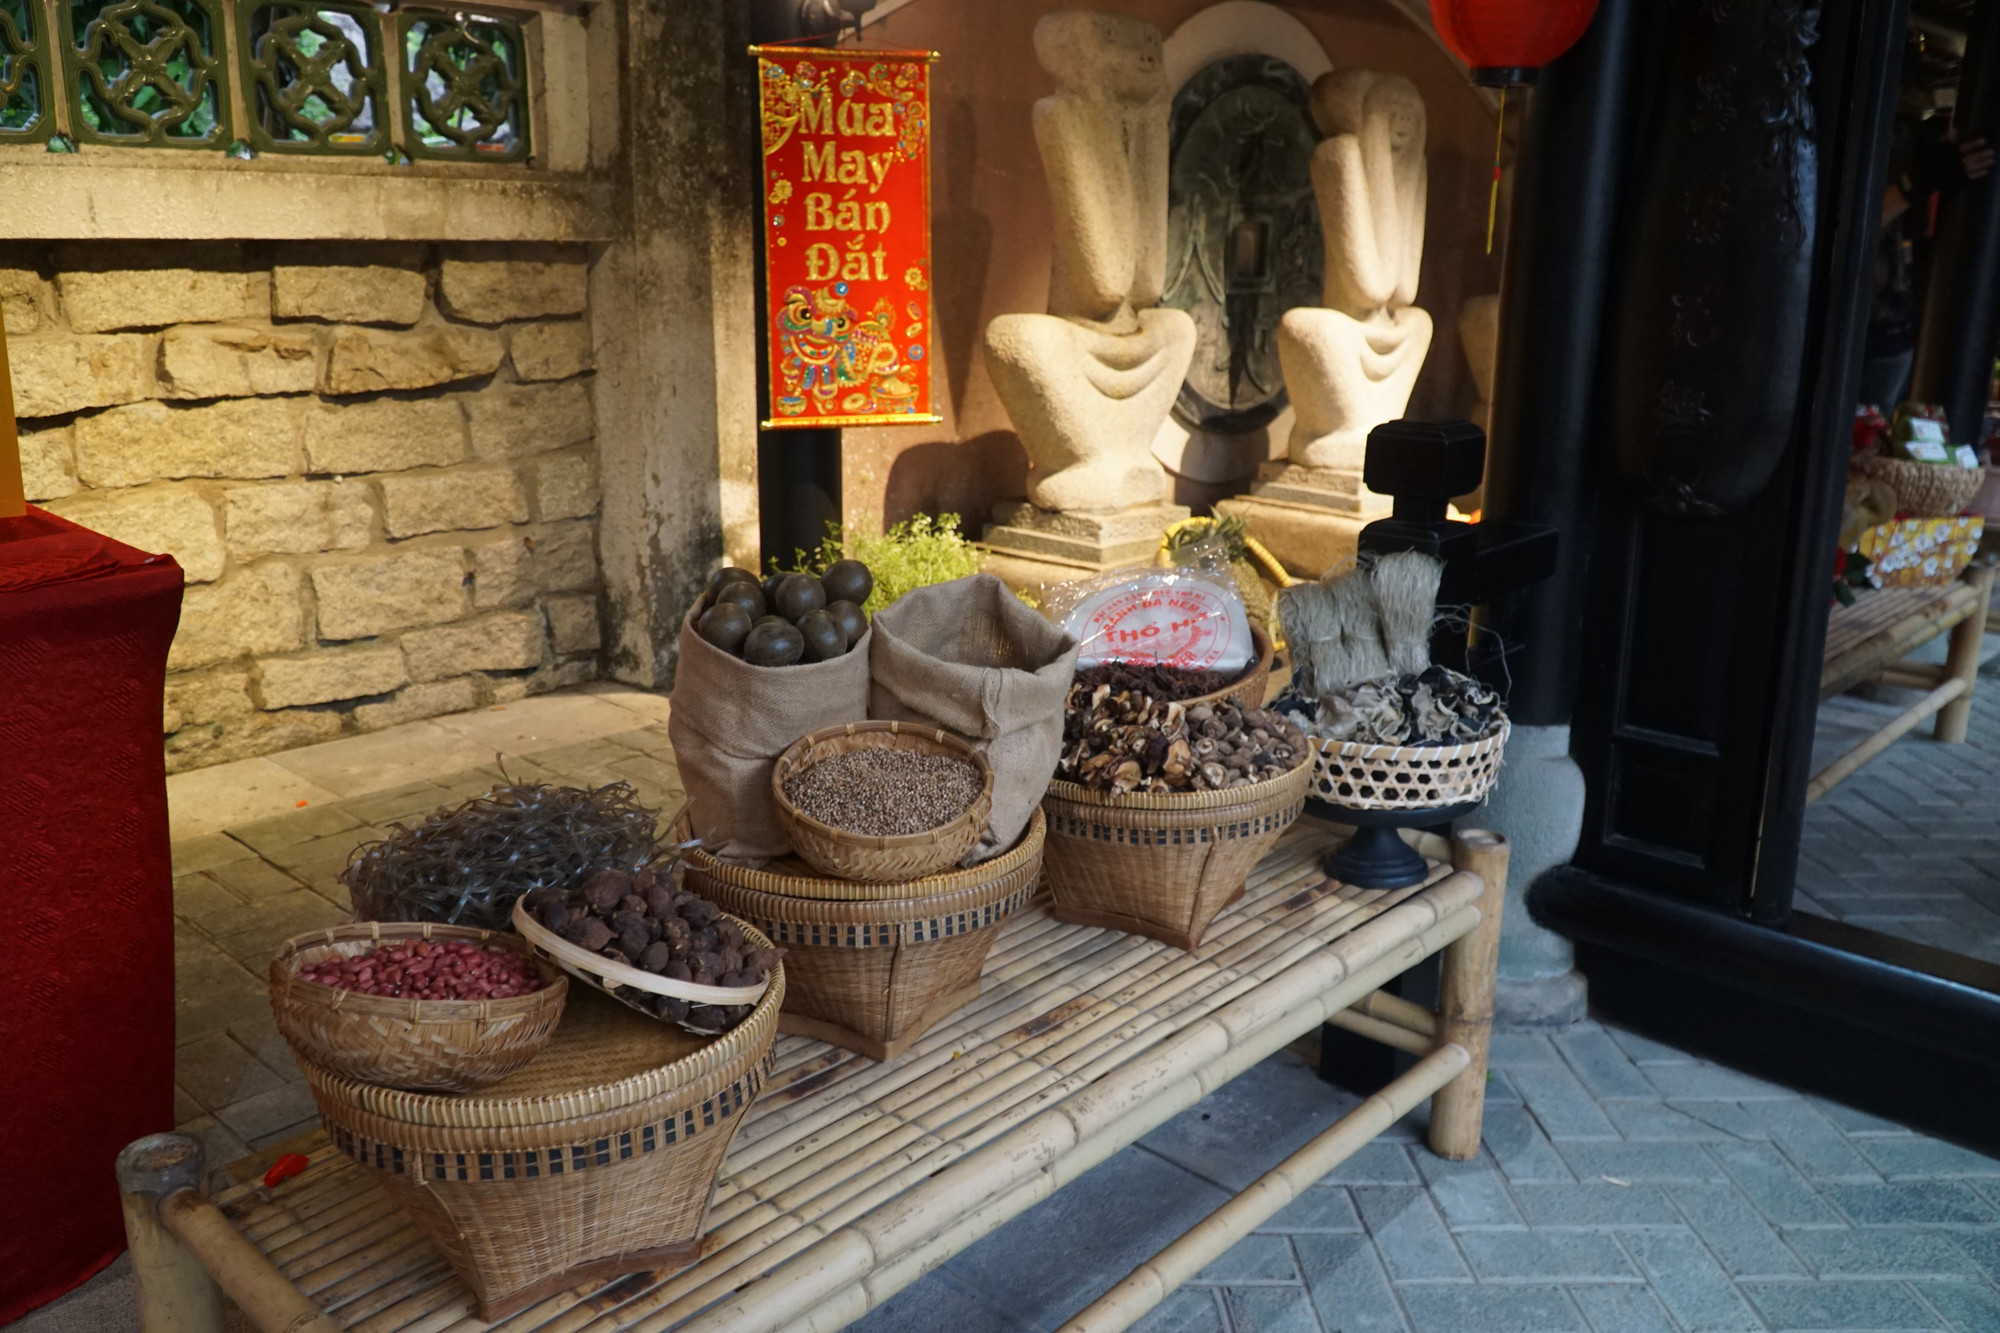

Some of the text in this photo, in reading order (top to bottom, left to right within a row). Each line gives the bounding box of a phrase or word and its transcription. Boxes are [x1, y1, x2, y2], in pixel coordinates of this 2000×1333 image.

[801, 140, 893, 194] May
[803, 188, 891, 235] Bán
[804, 233, 890, 281] Đắt
